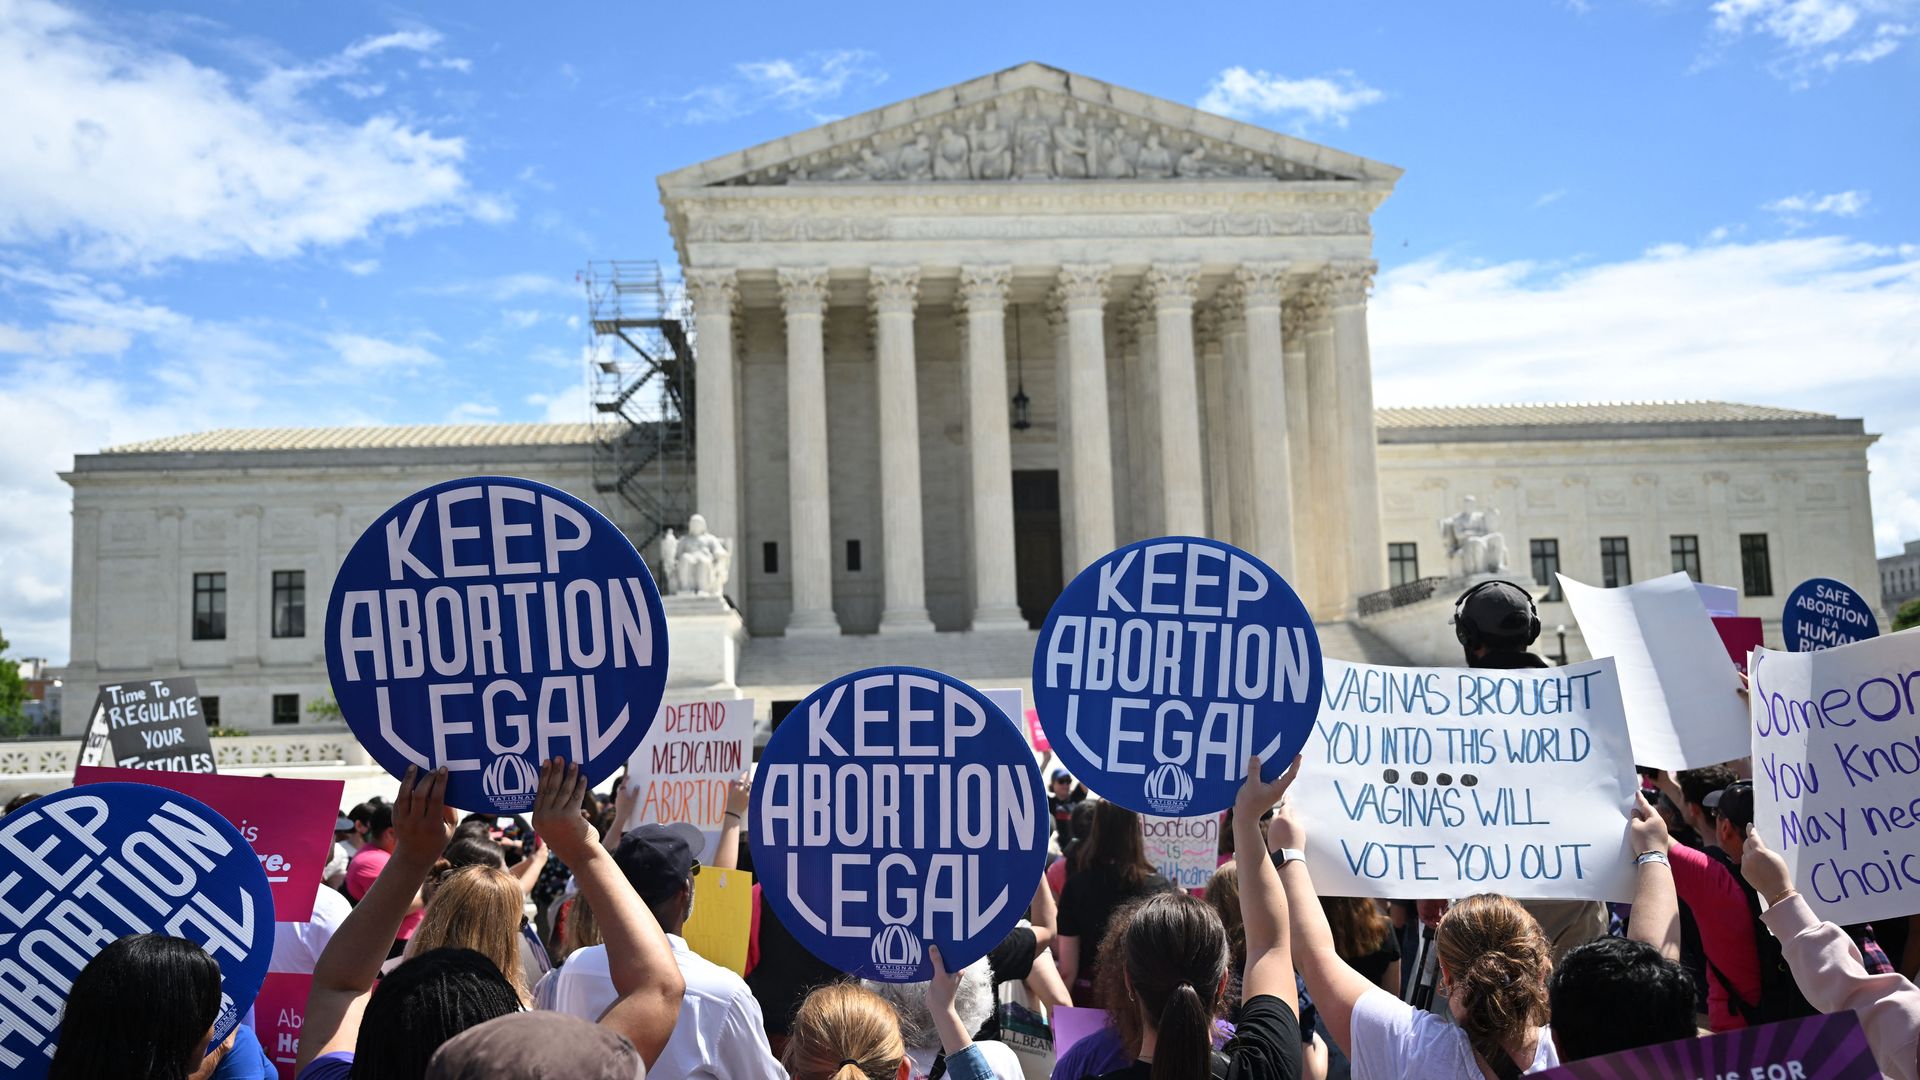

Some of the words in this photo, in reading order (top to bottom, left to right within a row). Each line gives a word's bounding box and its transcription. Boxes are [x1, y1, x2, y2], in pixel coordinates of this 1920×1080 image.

[385, 485, 592, 581] KEEP
[1097, 543, 1269, 618] KEEP
[1816, 584, 1851, 606] SAFE
[339, 577, 653, 682] ABORTION
[1796, 595, 1869, 627] ABORTION
[1821, 617, 1830, 627] IS
[1832, 620, 1839, 630] A
[1046, 615, 1310, 704] ABORTION
[106, 685, 146, 705] Time
[150, 681, 170, 698] To
[108, 696, 198, 729] REGULATE
[1323, 667, 1451, 715] VAGINAS
[1458, 670, 1602, 716] BROUGHT
[141, 727, 185, 749] YOUR
[375, 674, 630, 772] LEGAL
[666, 701, 726, 732] DEFEND
[808, 674, 987, 757] KEEP
[1065, 694, 1281, 781] LEGAL
[651, 740, 742, 775] MEDICATION
[1317, 720, 1371, 765] YOU
[1382, 727, 1432, 765] INTO
[1436, 727, 1496, 765] THIS
[1503, 727, 1591, 764] WORLD
[1834, 735, 1920, 787] Kno
[482, 754, 540, 796] NOW
[1144, 764, 1193, 801] NOW
[640, 779, 733, 825] ABORTIO
[761, 763, 1035, 851] ABORTION
[1334, 780, 1465, 828] VAGINAS
[1472, 787, 1550, 827] WILL
[241, 820, 258, 842] is
[1142, 815, 1217, 840] bortion
[0, 795, 109, 946] EEP
[1341, 839, 1439, 882] VOTE
[1445, 843, 1511, 882] YOU
[1520, 843, 1592, 880] OUT
[787, 852, 1009, 941] LEGAL
[871, 925, 922, 965] NOW
